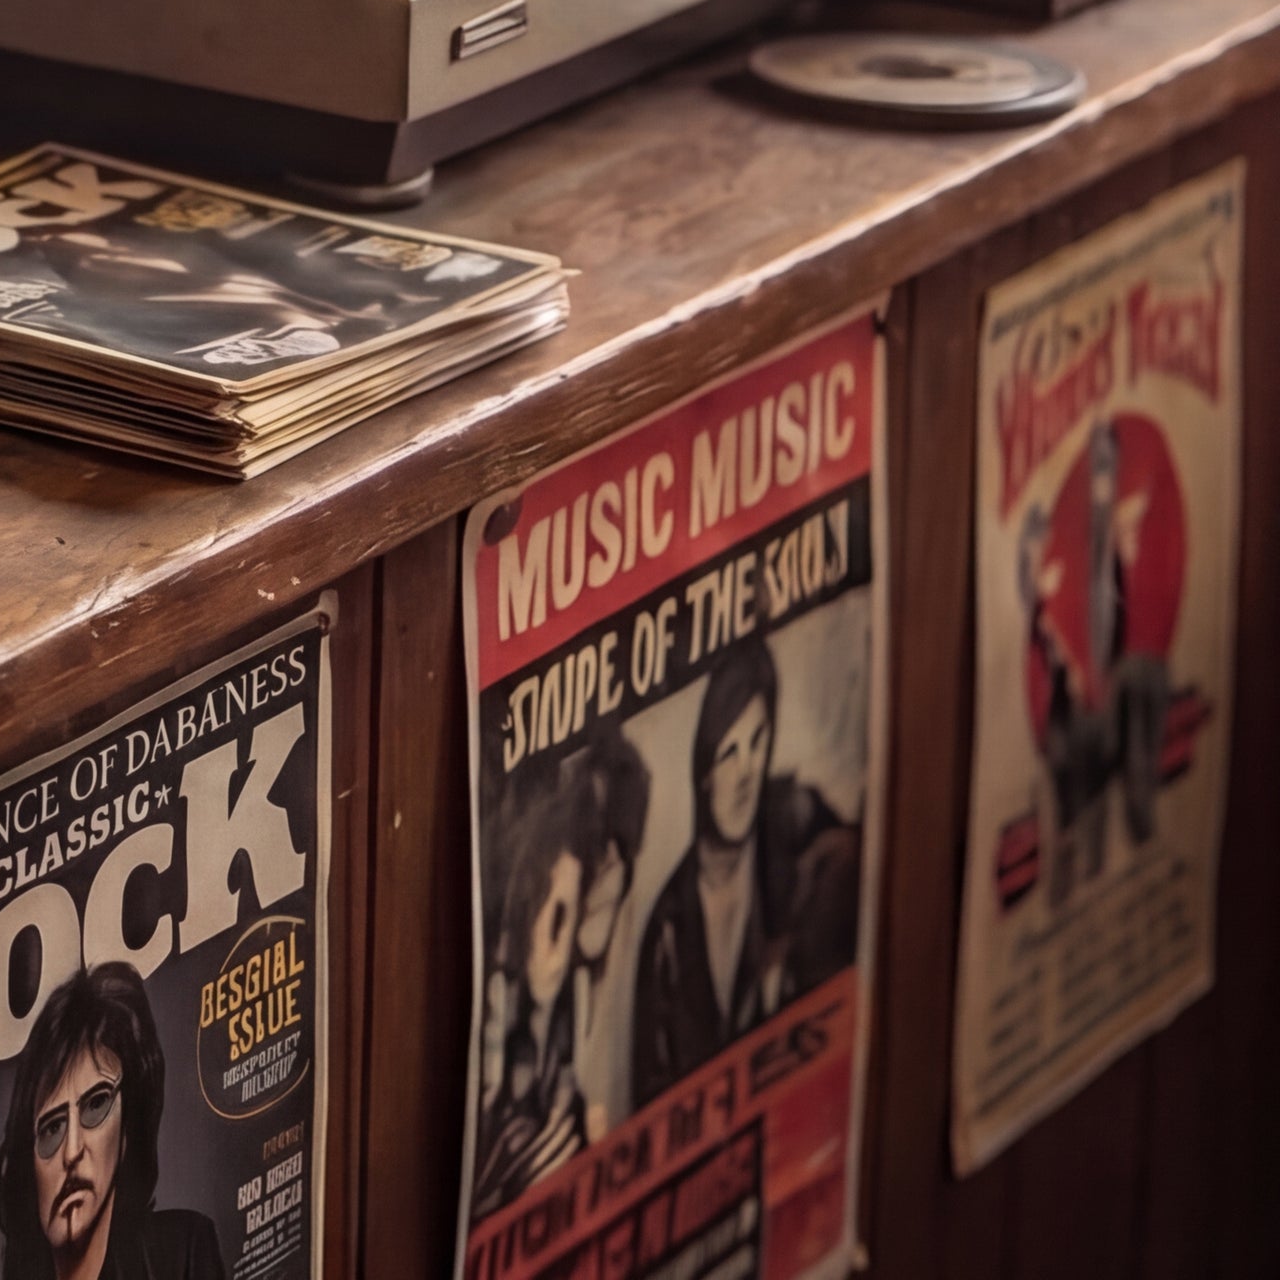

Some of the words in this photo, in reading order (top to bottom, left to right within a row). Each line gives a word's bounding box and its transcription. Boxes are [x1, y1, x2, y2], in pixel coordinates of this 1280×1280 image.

[498, 451, 674, 642] MUSIC
[689, 361, 856, 538] MUSIC
[631, 597, 677, 696] OF
[686, 551, 757, 663] THE
[69, 745, 119, 802] OF
